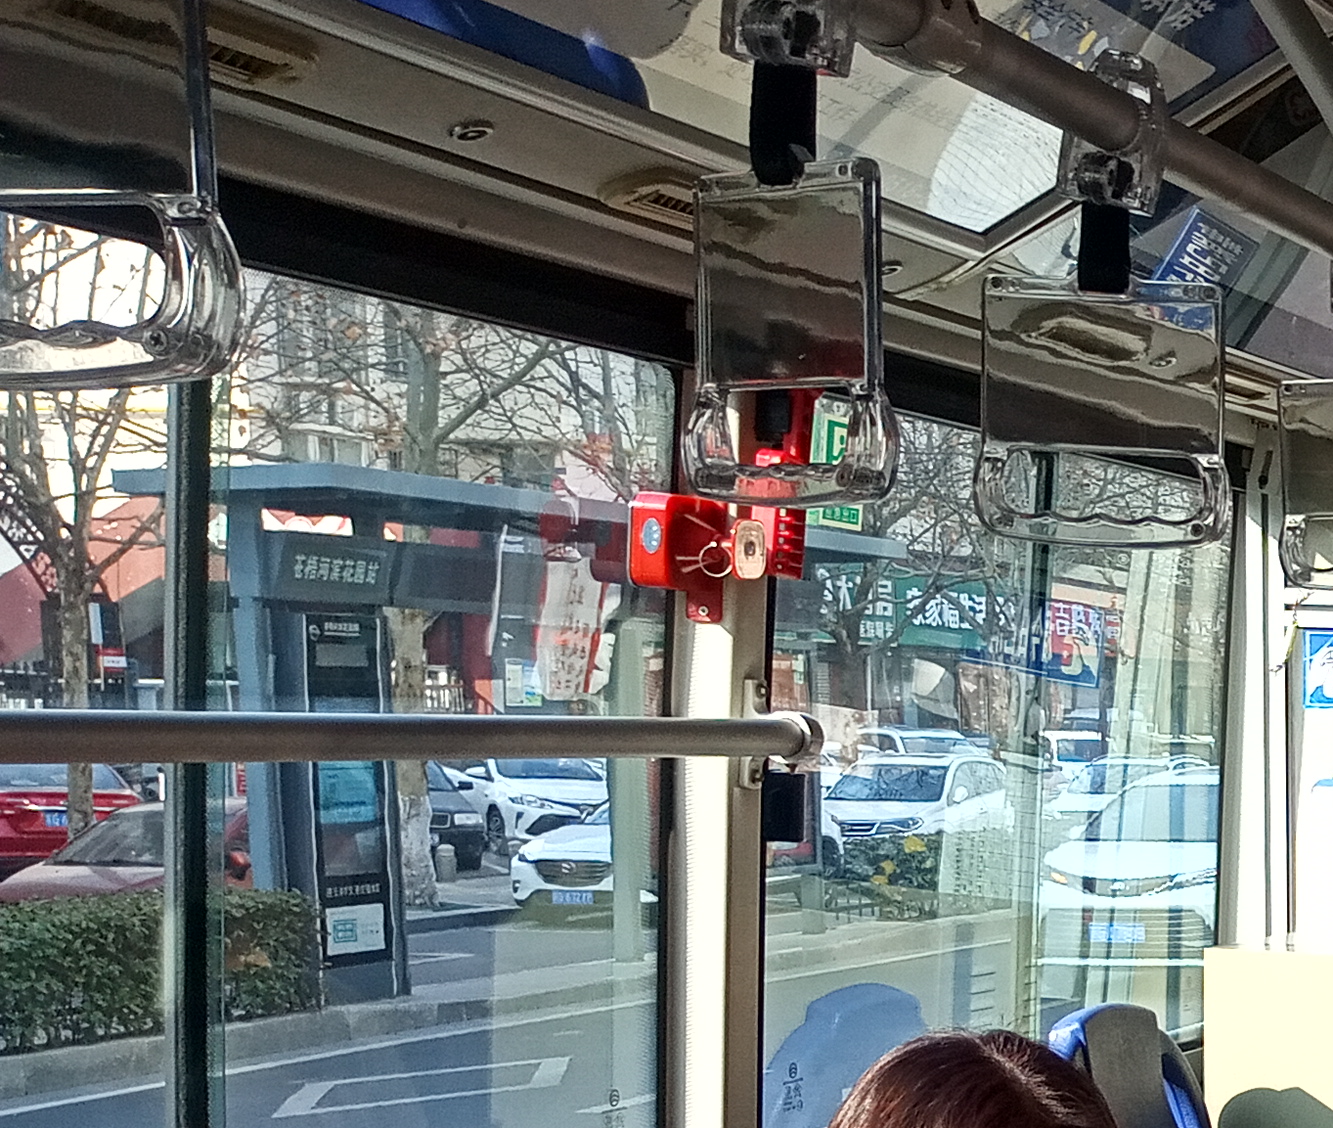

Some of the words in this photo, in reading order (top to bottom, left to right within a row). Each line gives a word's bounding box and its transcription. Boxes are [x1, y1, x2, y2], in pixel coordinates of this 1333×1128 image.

[293, 553, 380, 585] 苍梧河滨花园站
